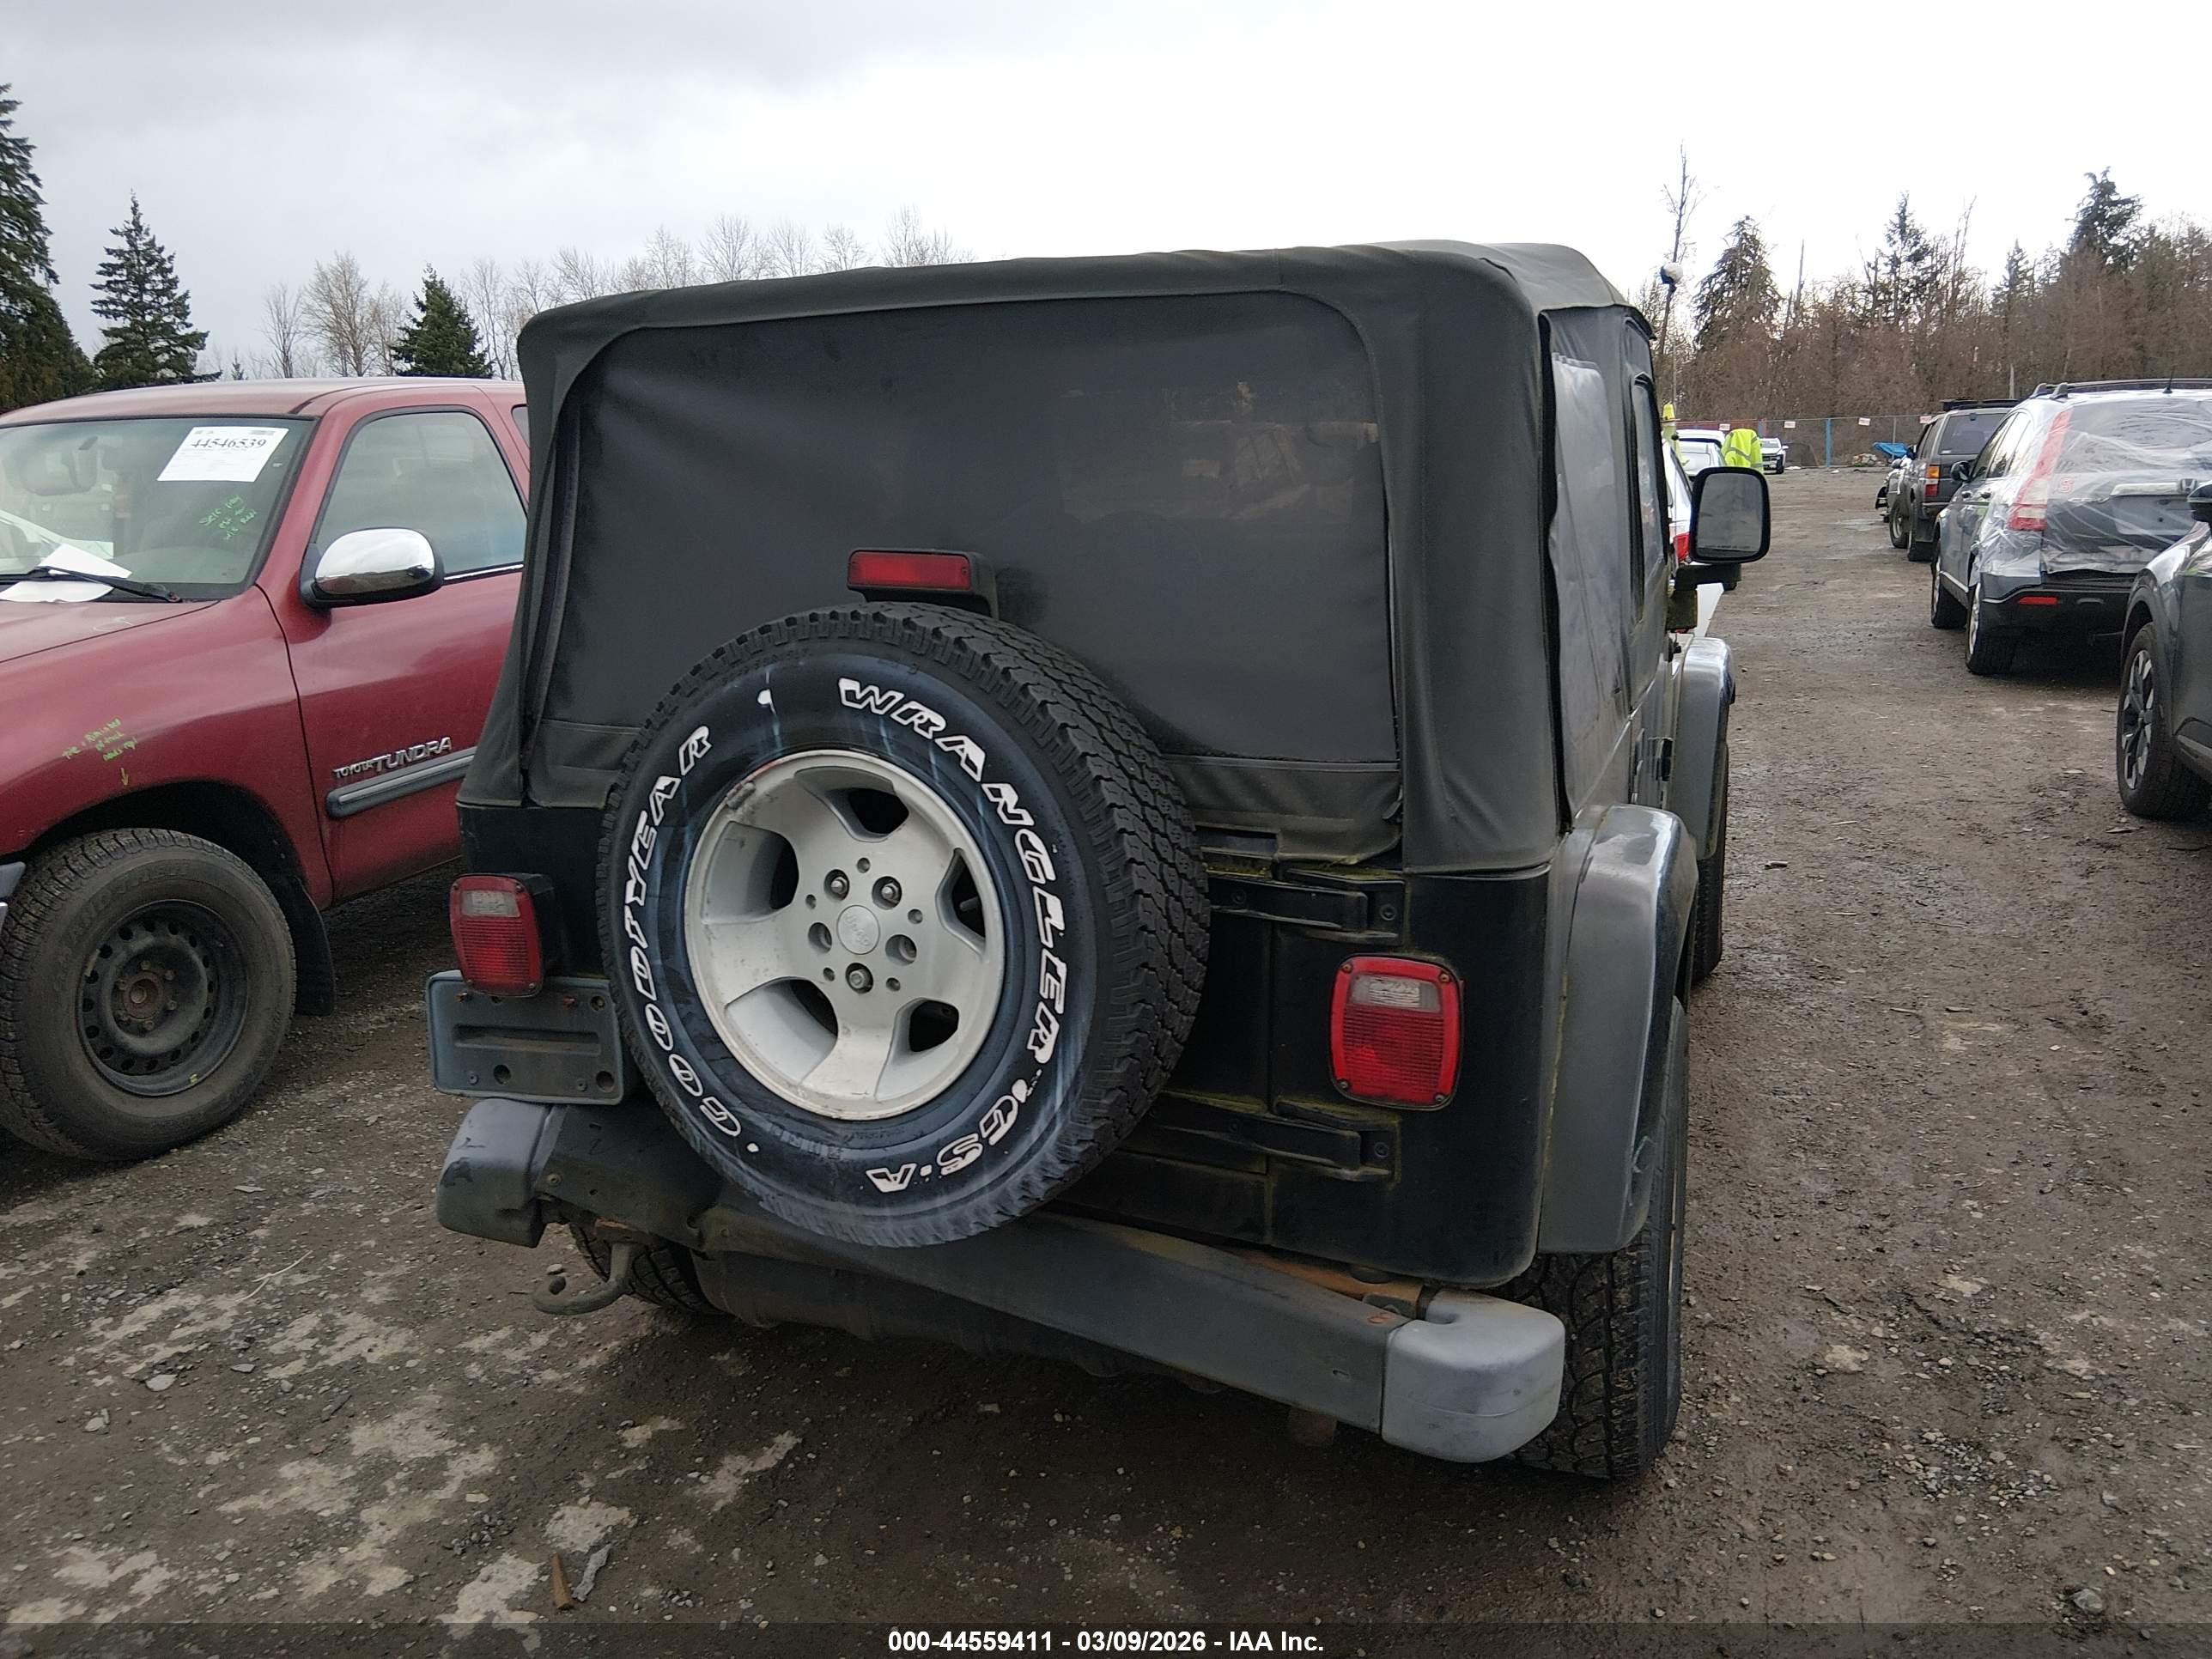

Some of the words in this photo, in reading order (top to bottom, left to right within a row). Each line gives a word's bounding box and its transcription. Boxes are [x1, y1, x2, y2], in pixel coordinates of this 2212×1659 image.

[191, 438, 268, 449] 44546539
[333, 762, 374, 779] TOYOTA
[374, 736, 453, 772] TUNDRA
[624, 725, 741, 1138] GOODYEAR
[839, 678, 1067, 1065] WRANGLER
